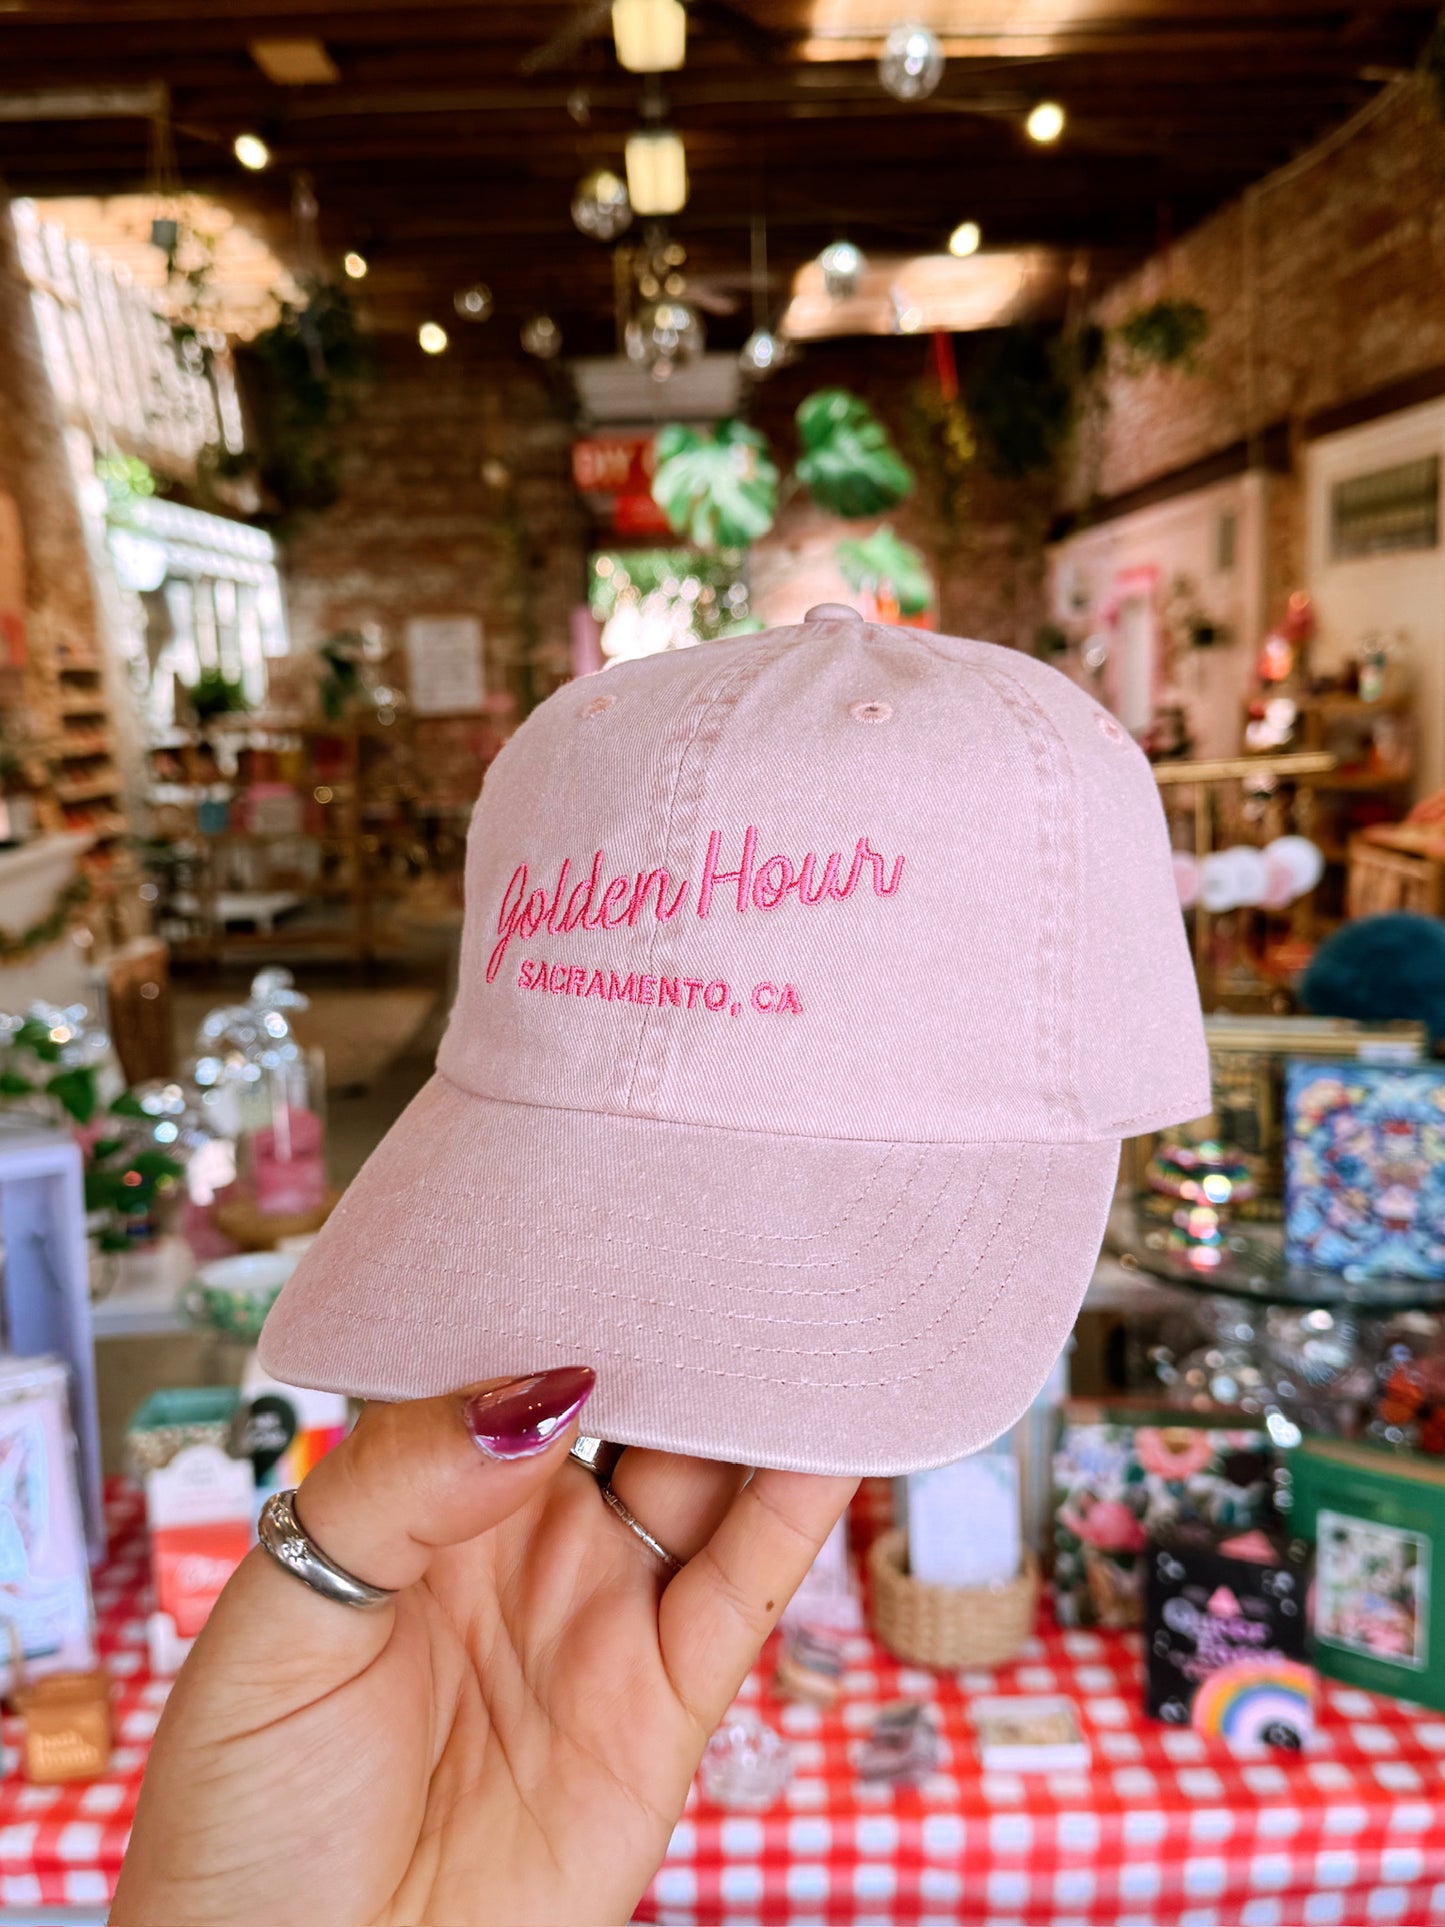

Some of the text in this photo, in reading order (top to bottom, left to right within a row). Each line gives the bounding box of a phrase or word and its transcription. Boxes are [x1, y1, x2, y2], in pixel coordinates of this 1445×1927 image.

[486, 825, 905, 984] Golden Hour
[517, 959, 804, 1017] SACRAMENTO, CA
